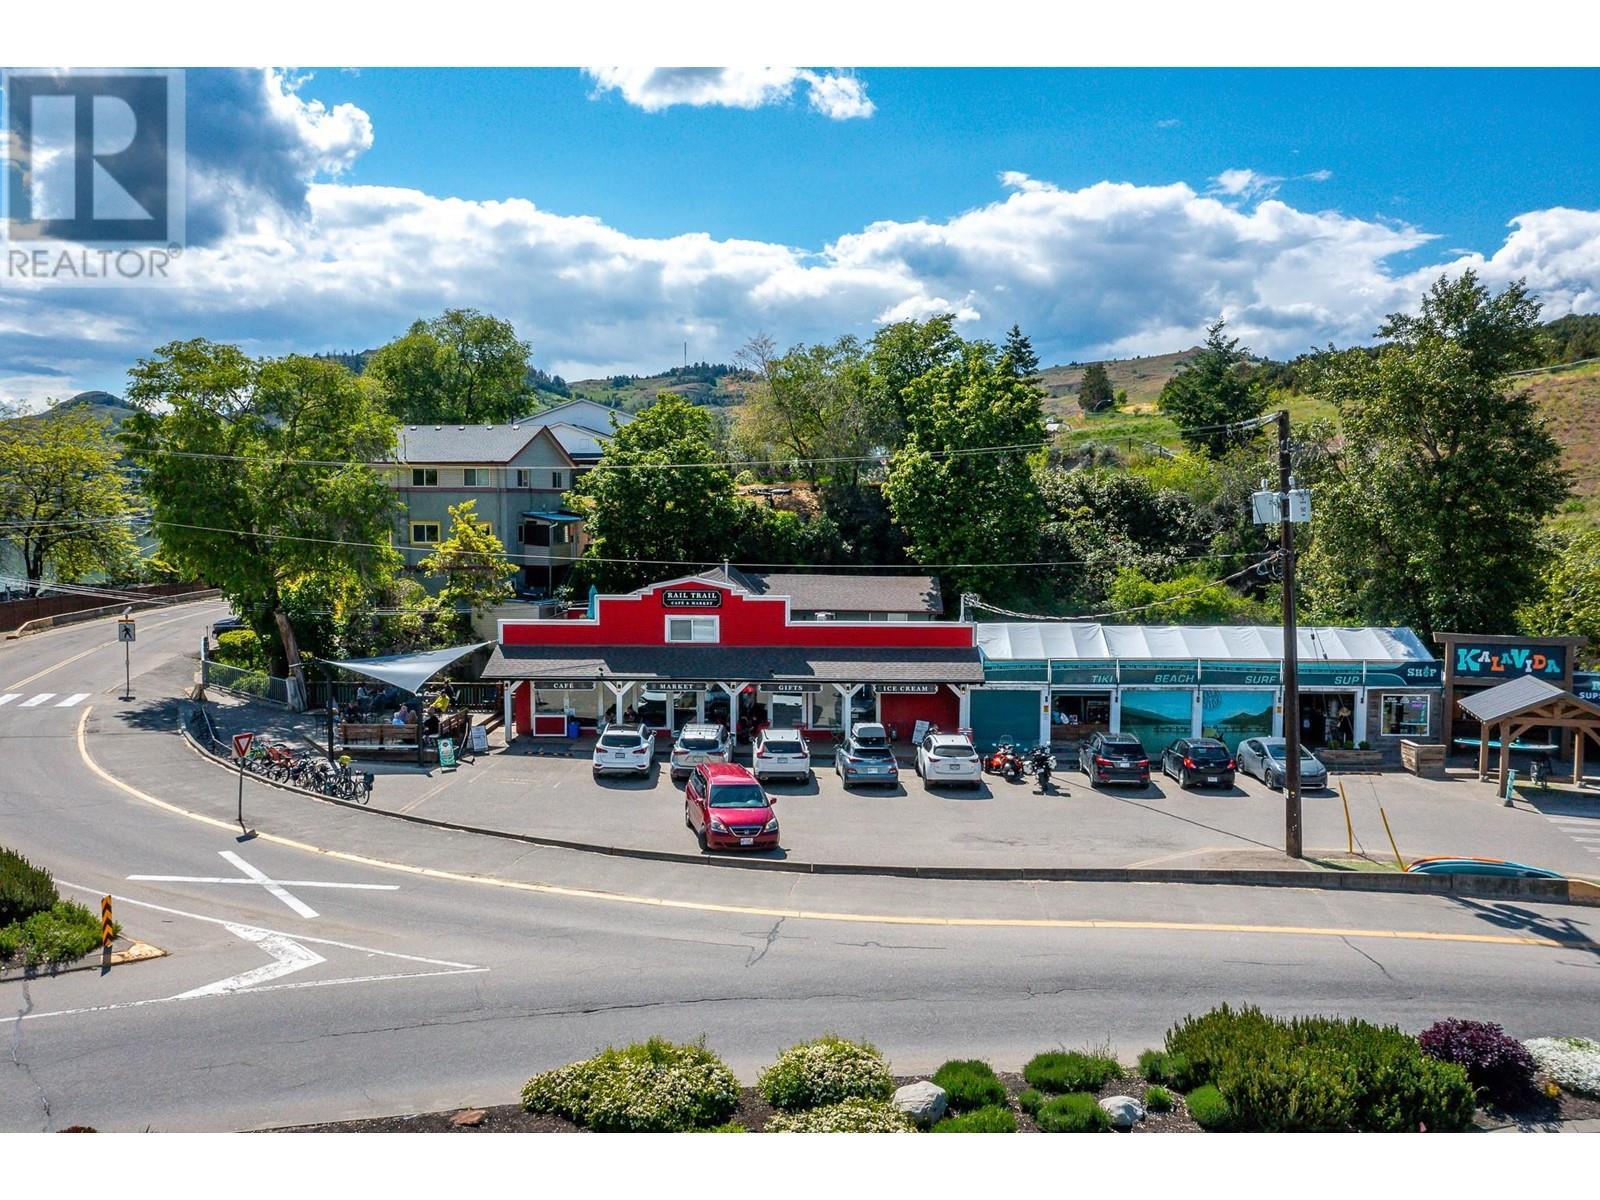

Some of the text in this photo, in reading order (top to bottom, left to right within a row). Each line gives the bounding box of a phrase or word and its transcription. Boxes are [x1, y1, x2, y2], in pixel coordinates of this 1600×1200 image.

[1457, 648, 1561, 673] KALAVIDA
[1091, 674, 1360, 685] TIKI BEACH SURF SUP
